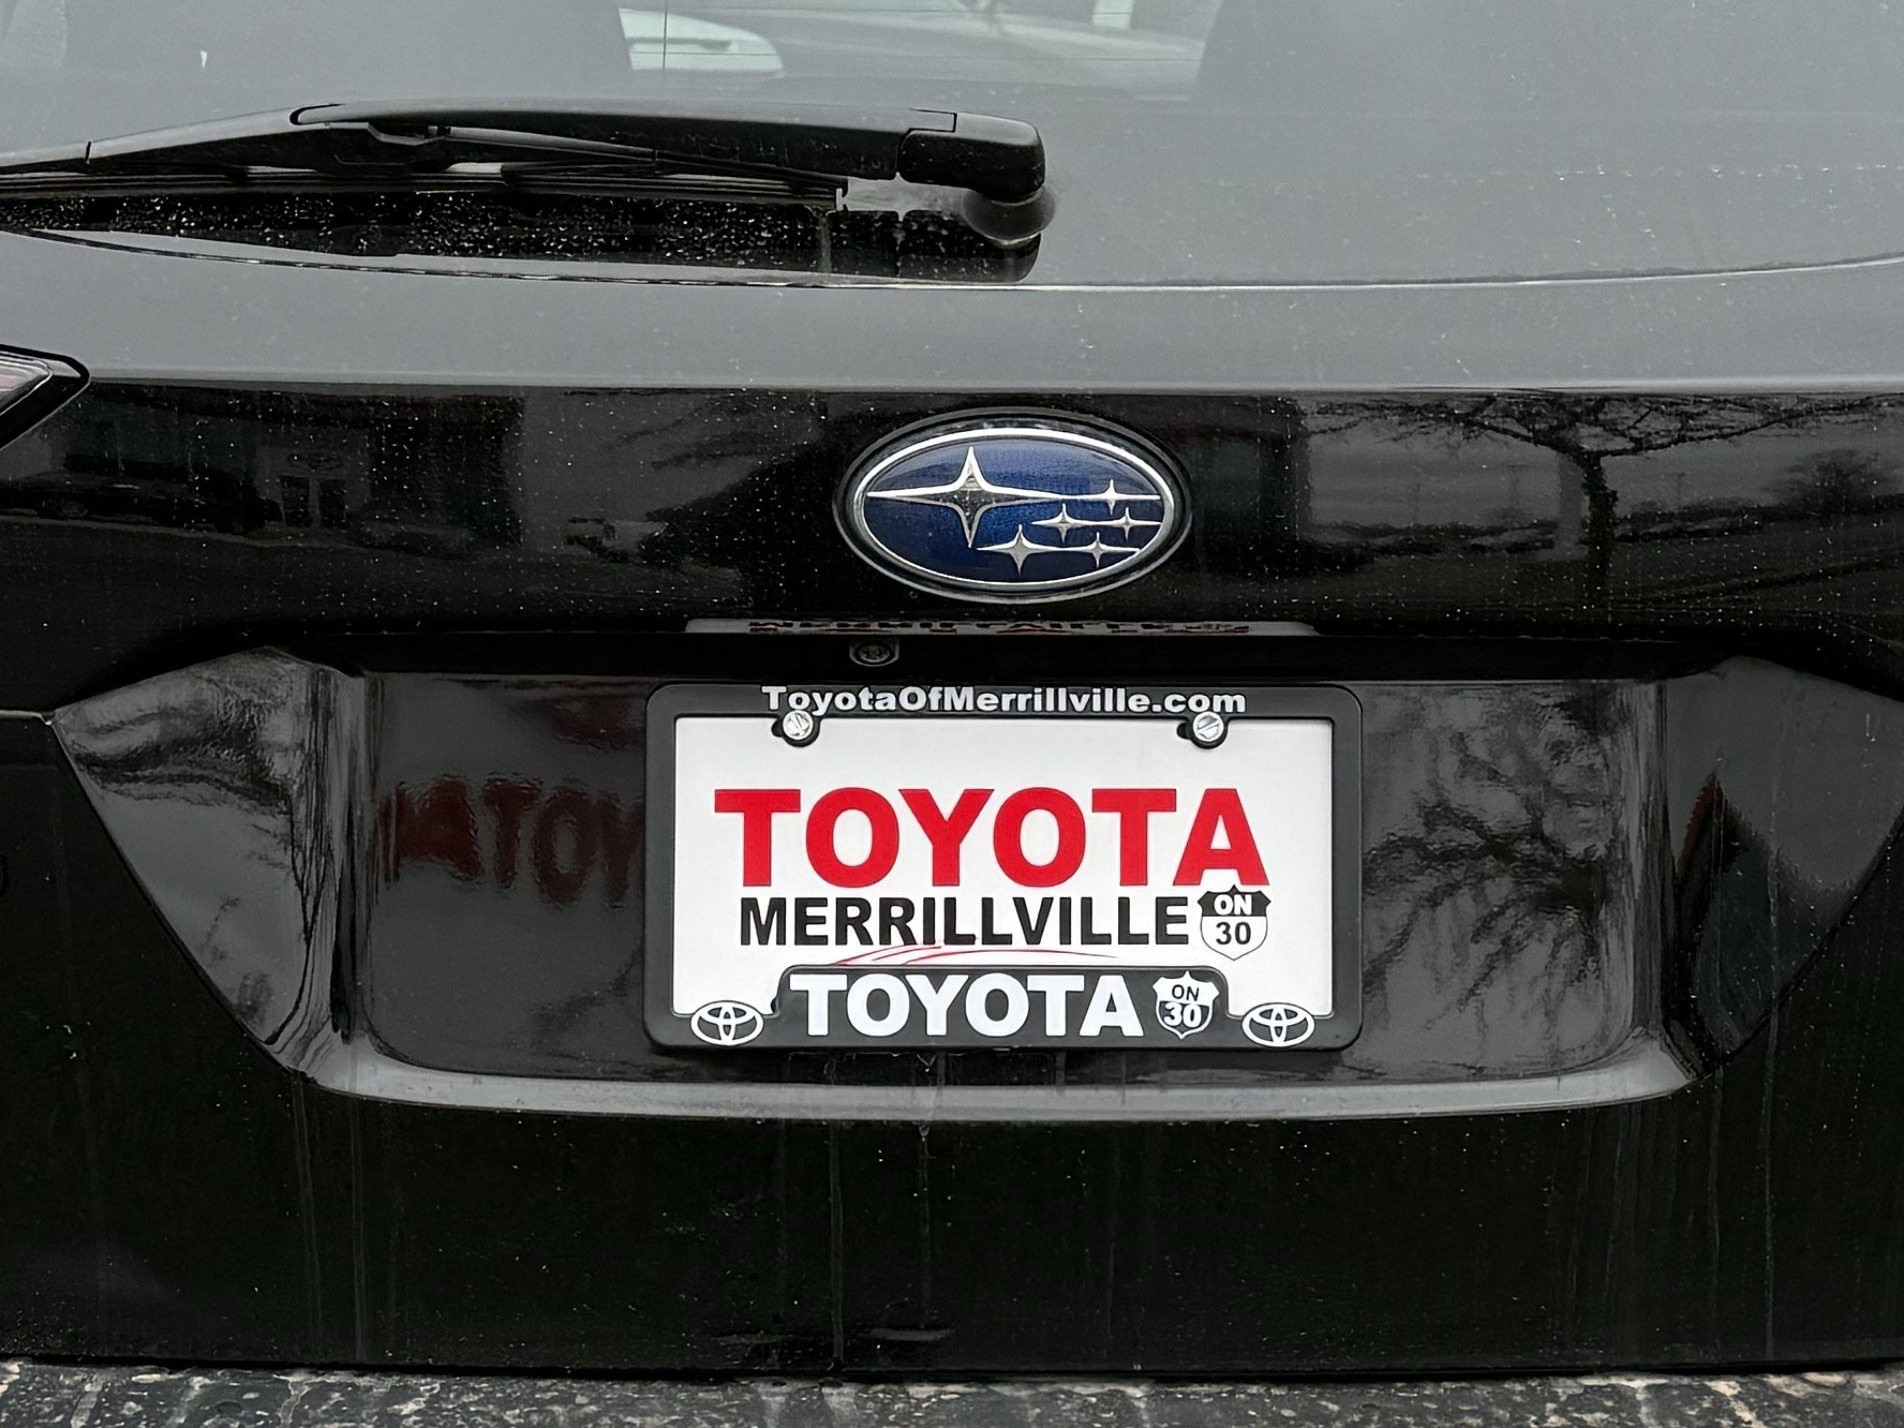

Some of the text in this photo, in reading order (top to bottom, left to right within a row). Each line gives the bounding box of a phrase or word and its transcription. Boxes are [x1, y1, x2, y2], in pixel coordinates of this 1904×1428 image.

[761, 685, 1246, 716] ToyotaOfMerrillville.com
[714, 786, 1270, 888] TOYOTA
[1213, 893, 1253, 916] ON
[739, 896, 1189, 947] MERRILLVILLE
[1215, 921, 1252, 946] 30
[789, 973, 1145, 1039] TOYOTA
[1171, 984, 1200, 1002] ON
[1163, 1001, 1203, 1029] 30
